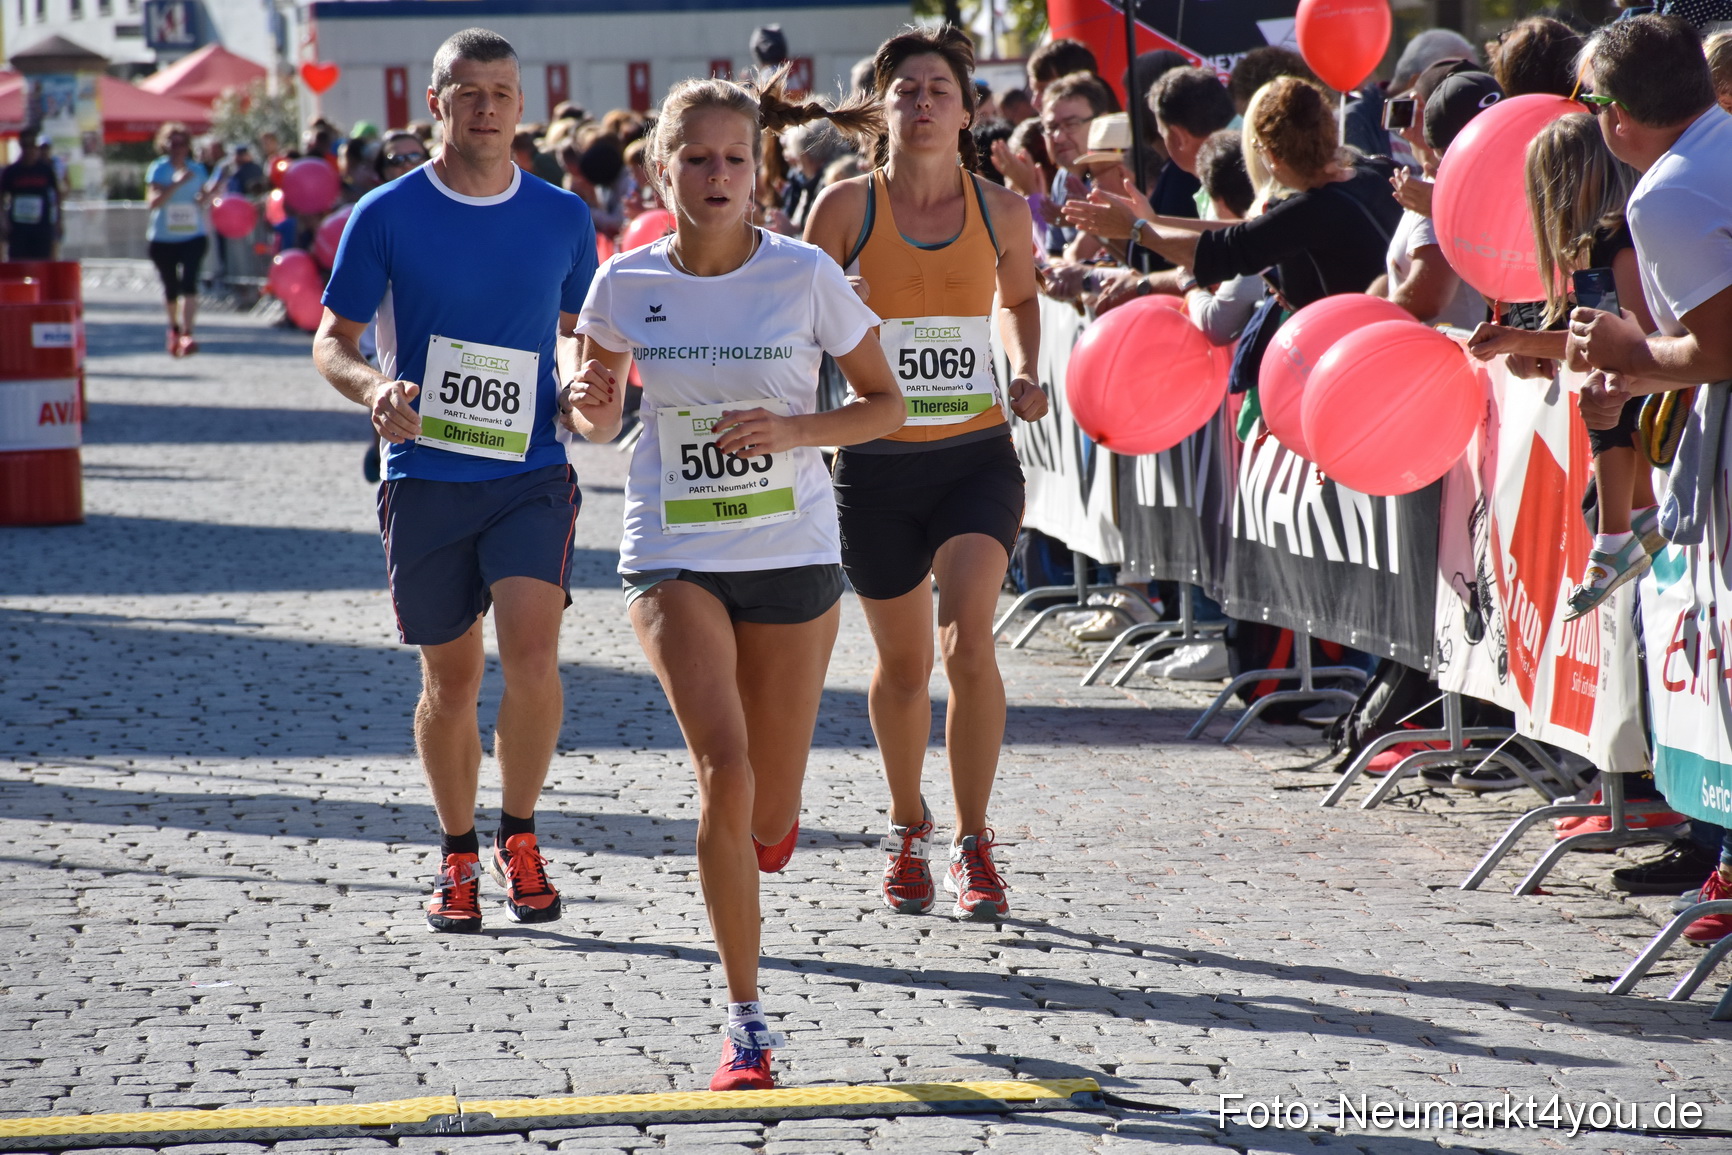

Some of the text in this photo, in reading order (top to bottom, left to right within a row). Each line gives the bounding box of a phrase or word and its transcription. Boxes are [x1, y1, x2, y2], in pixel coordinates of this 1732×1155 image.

[645, 315, 667, 323] erima
[915, 327, 961, 339] BOCK
[632, 346, 793, 361] RUPPRECHT HOLZBAU
[462, 352, 510, 371] BOCK
[898, 347, 976, 380] 5069
[439, 371, 520, 414] 5068
[932, 384, 964, 392] Neumarkt
[911, 399, 969, 414] Theresia
[444, 409, 503, 425] PARTL Neumarkt
[444, 424, 505, 447] Christian
[689, 481, 757, 494] PARTL Neumarkt
[713, 502, 748, 517] Tina
